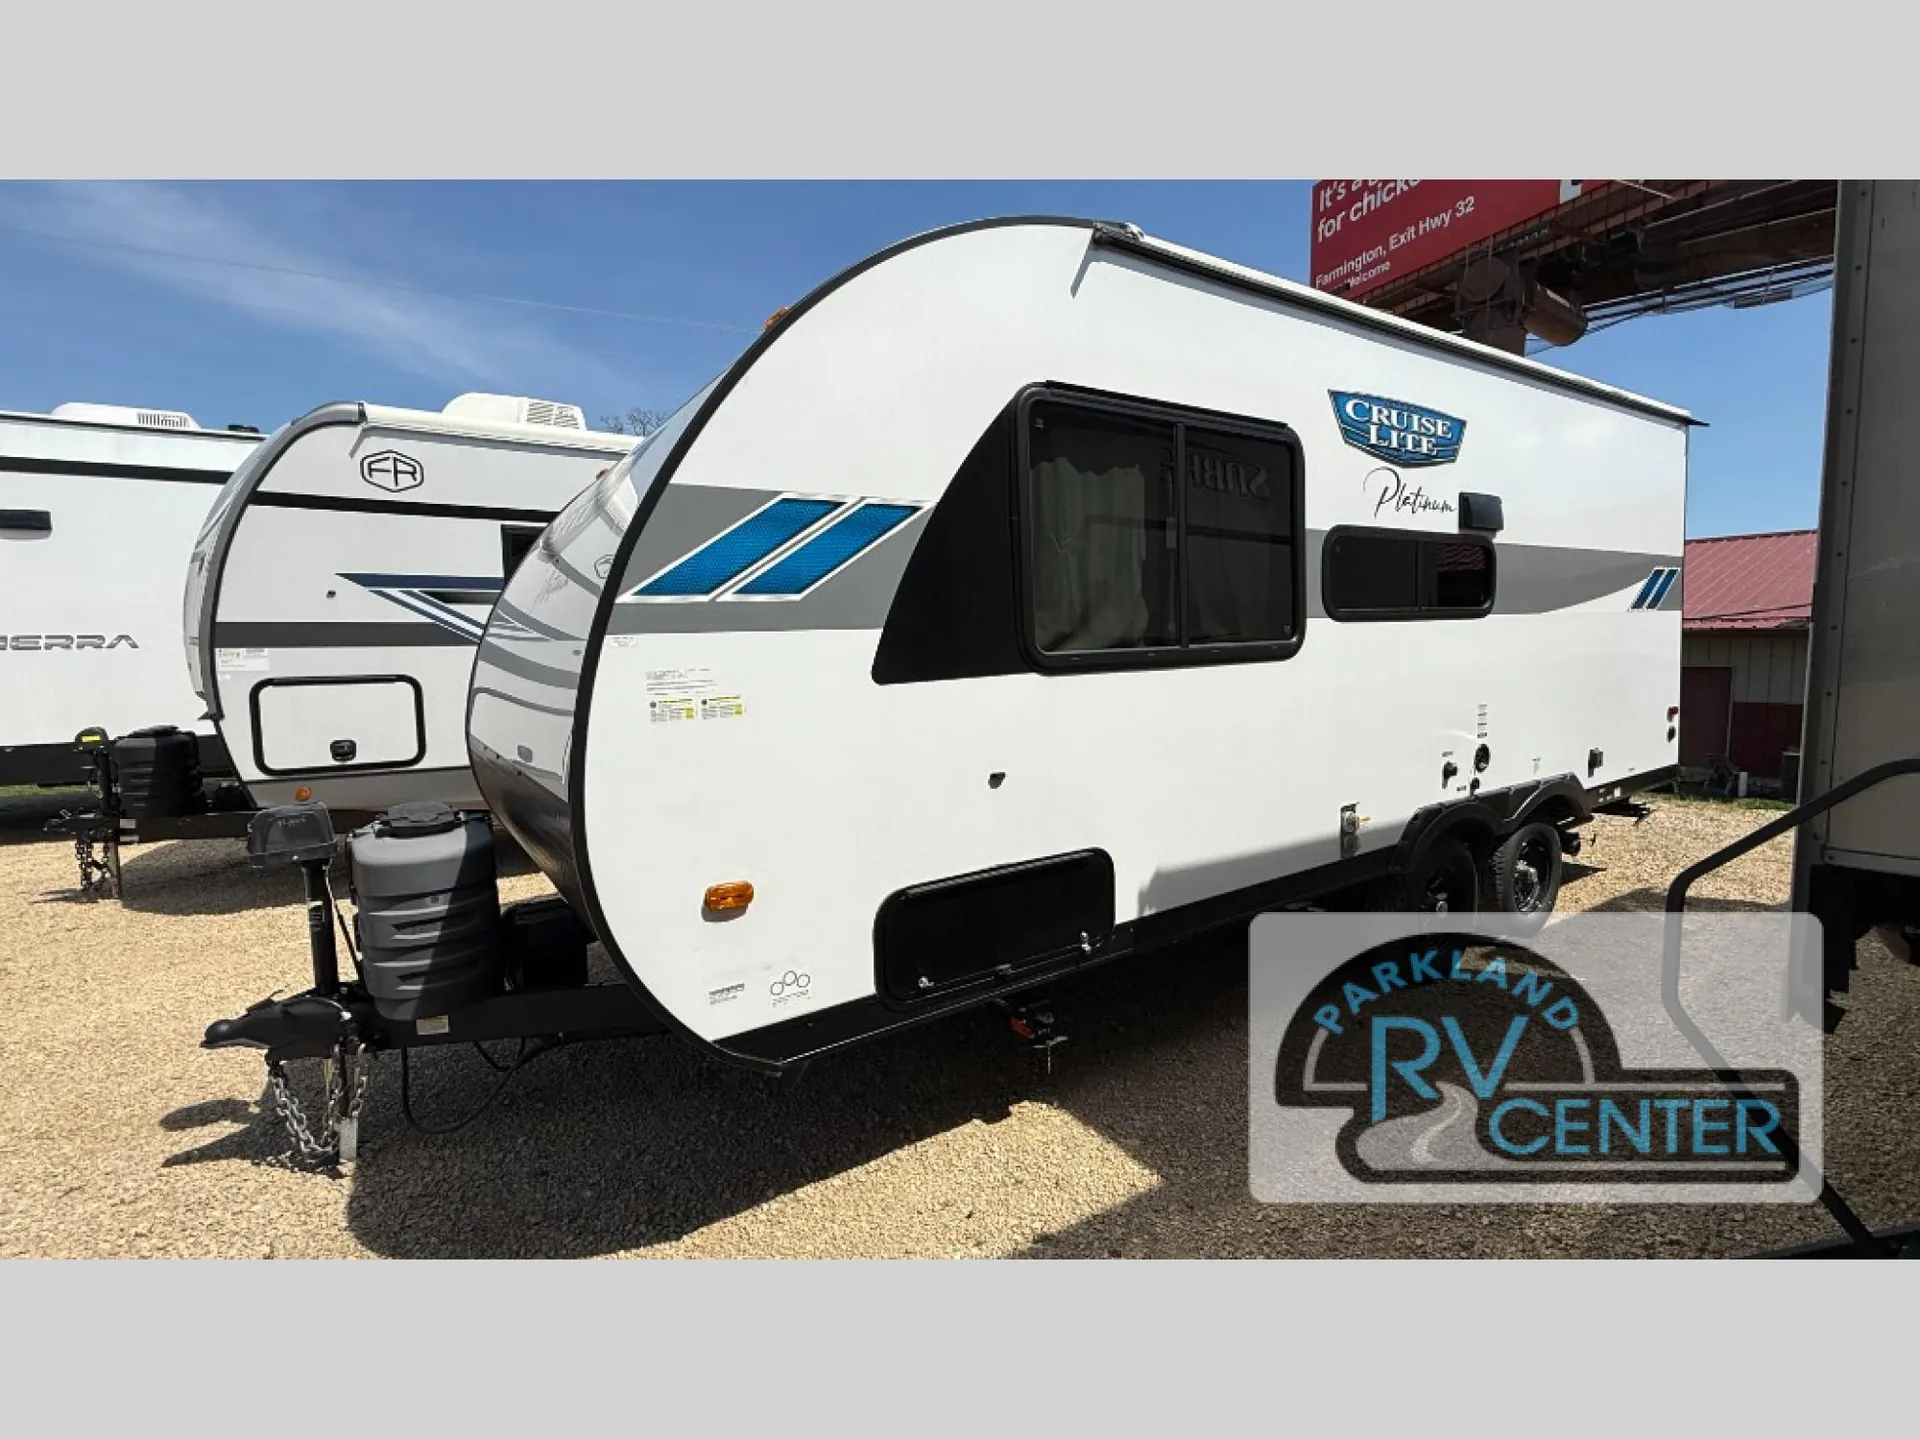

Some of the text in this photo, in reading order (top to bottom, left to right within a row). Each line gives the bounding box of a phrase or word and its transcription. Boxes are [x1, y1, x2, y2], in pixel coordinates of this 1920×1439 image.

[1319, 181, 1346, 212] It's
[1315, 195, 1475, 291] Farmington, Exit Hwy 32
[1318, 211, 1346, 243] for
[1345, 399, 1452, 438] CRUISE
[1368, 424, 1437, 456] LITE
[1363, 466, 1457, 520] Platinum
